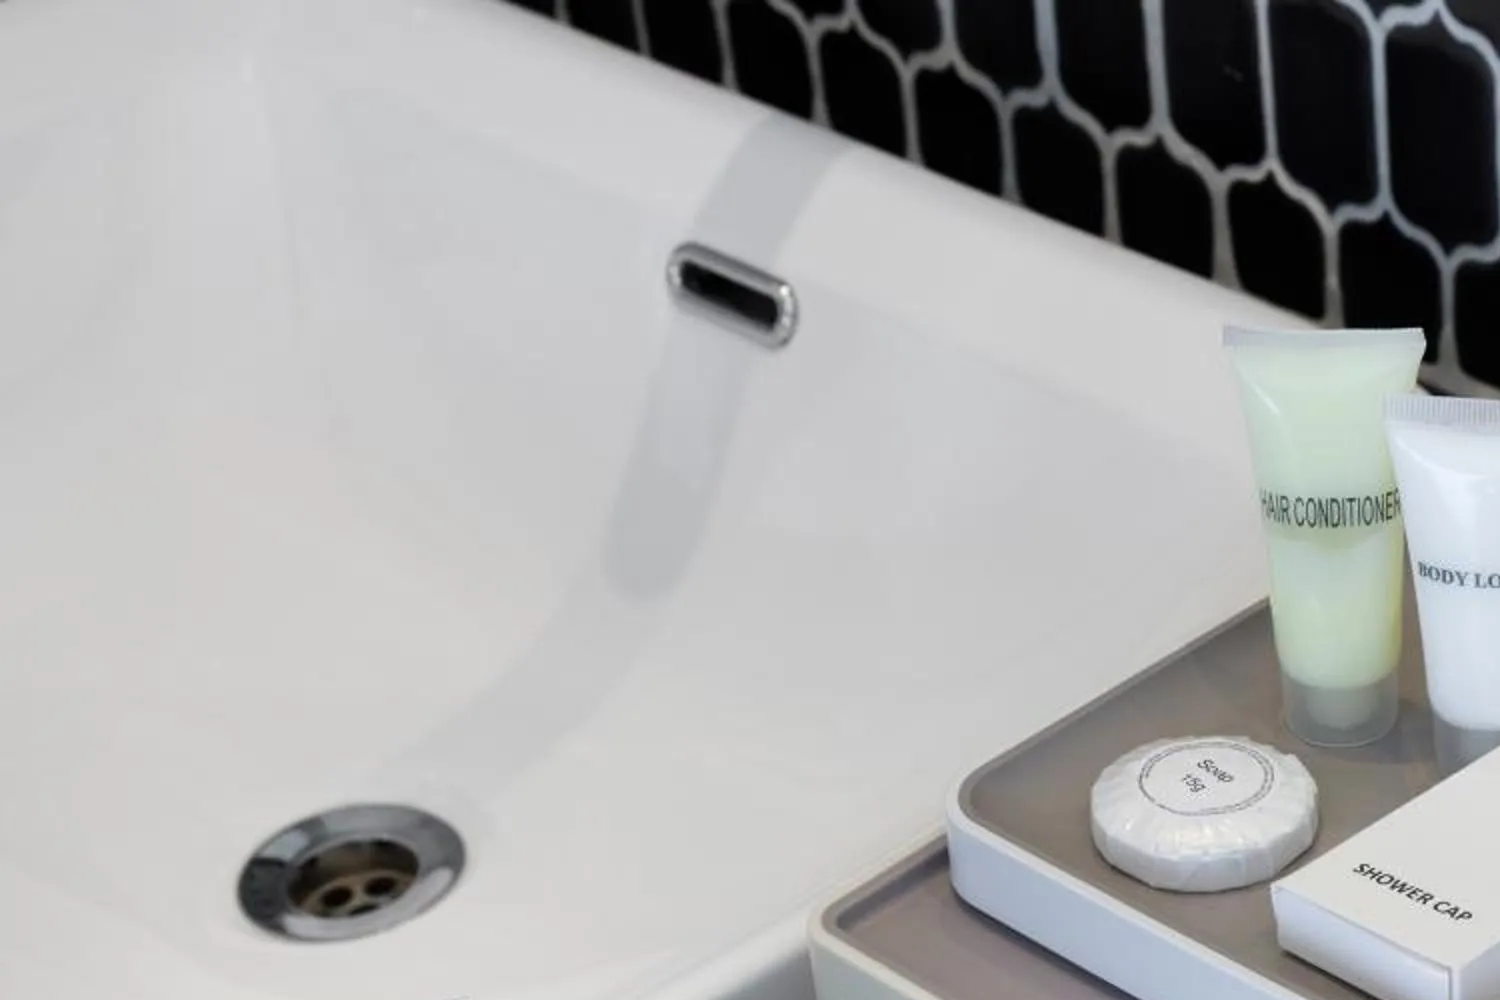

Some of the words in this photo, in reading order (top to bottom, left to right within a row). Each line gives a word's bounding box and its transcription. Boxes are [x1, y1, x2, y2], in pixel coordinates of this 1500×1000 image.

[1260, 487, 1291, 526] HAIR
[1293, 487, 1401, 529] CONDITIONER
[1417, 560, 1469, 588] BODY
[1197, 758, 1234, 783] Soap
[1352, 861, 1433, 907] SHOWER
[1432, 899, 1474, 924] CAP
